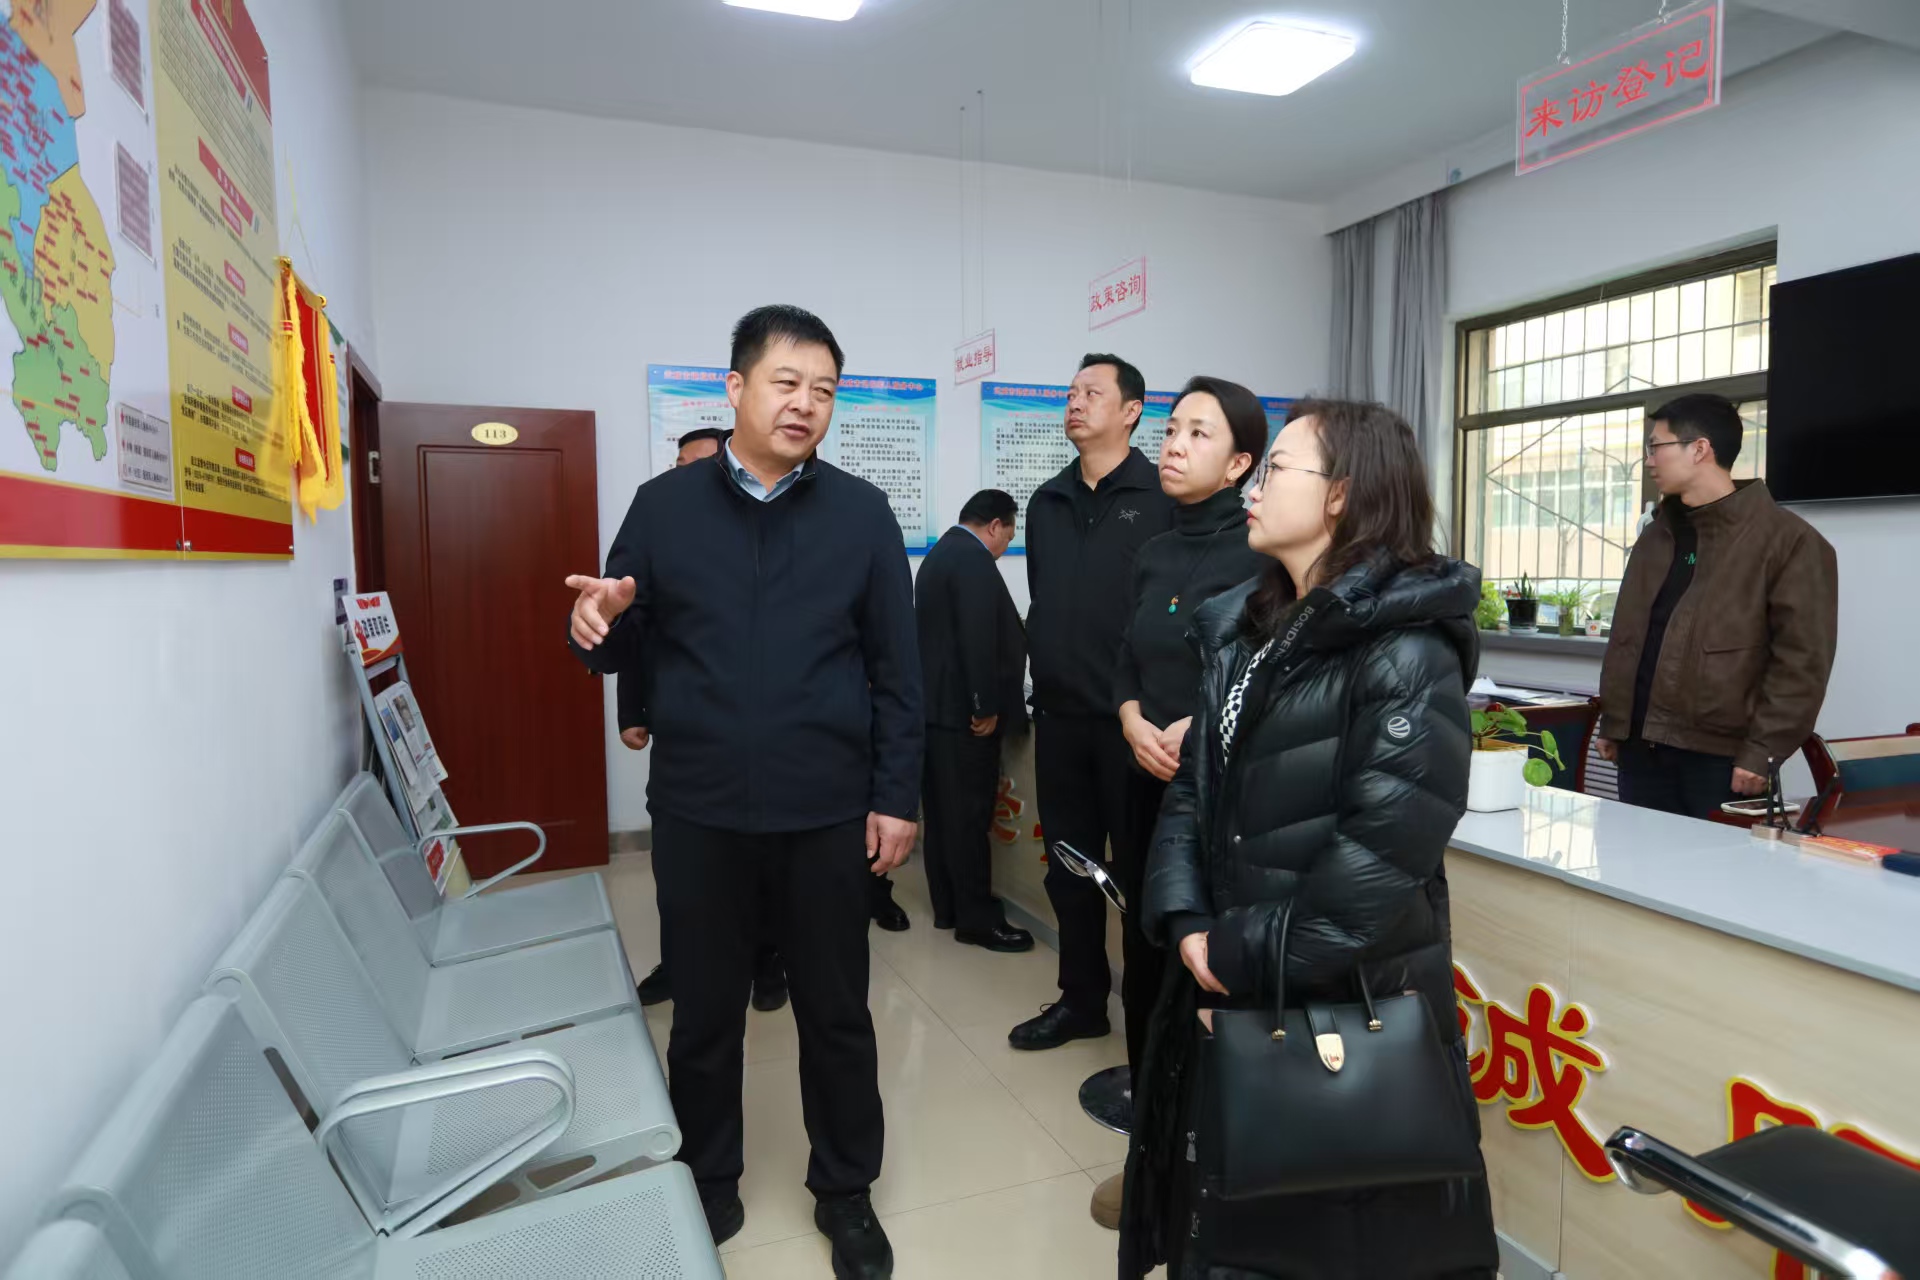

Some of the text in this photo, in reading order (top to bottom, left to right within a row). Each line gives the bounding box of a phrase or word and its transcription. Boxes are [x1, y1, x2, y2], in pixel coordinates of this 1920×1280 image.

[1525, 38, 1707, 138] 来访登记
[1089, 274, 1141, 312] 政策咨询
[955, 344, 993, 372] 就业指导
[664, 369, 727, 382] 武威市退役军人
[485, 429, 507, 439] 113
